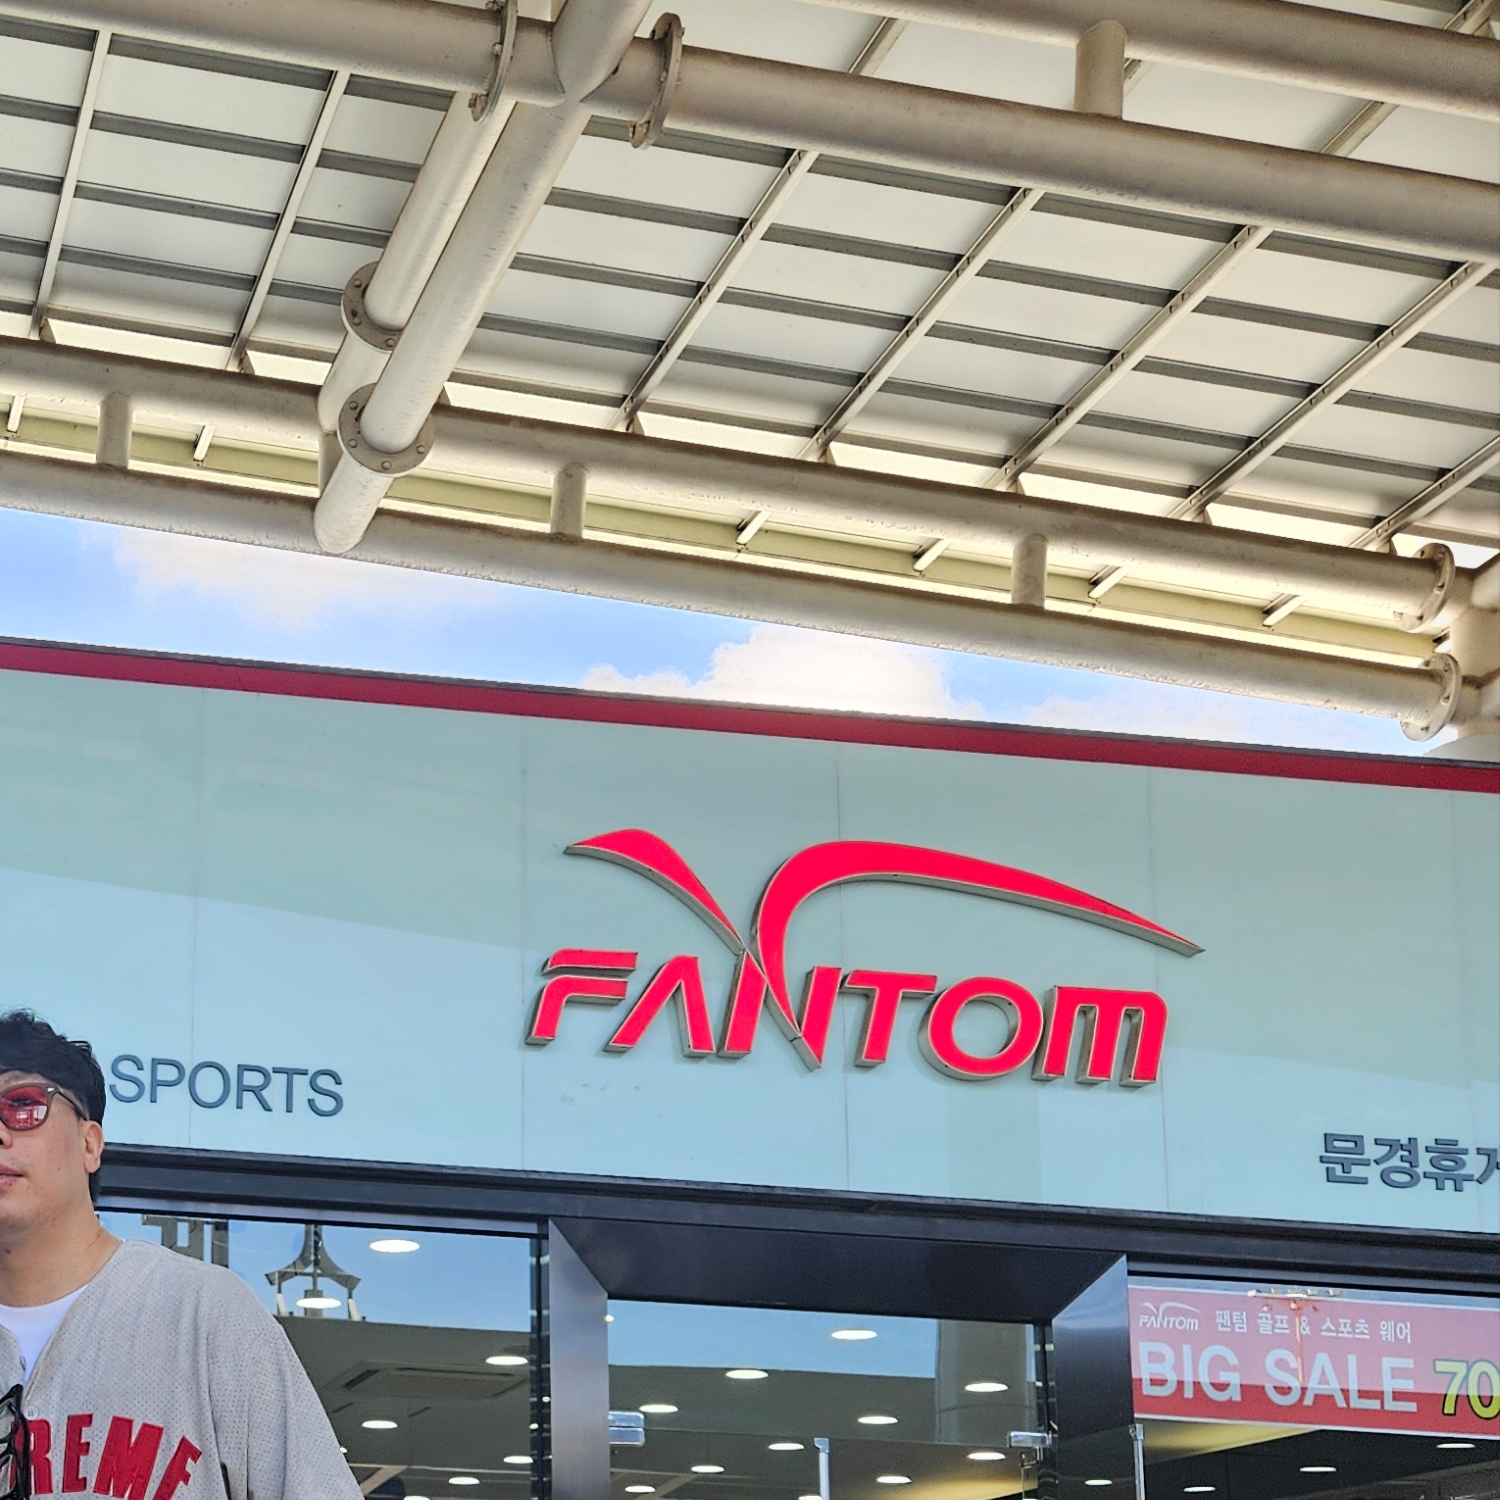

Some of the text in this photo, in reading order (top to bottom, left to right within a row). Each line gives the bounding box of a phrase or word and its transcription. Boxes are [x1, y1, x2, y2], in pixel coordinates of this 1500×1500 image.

[524, 930, 1170, 1088] FANTOM
[109, 1054, 345, 1118] SPORTS
[1138, 1309, 1412, 1345] FANTOM 팬텀 골프 & 스포츠 웨어
[1138, 1341, 1243, 1402] BIG
[1264, 1348, 1418, 1413] SALE
